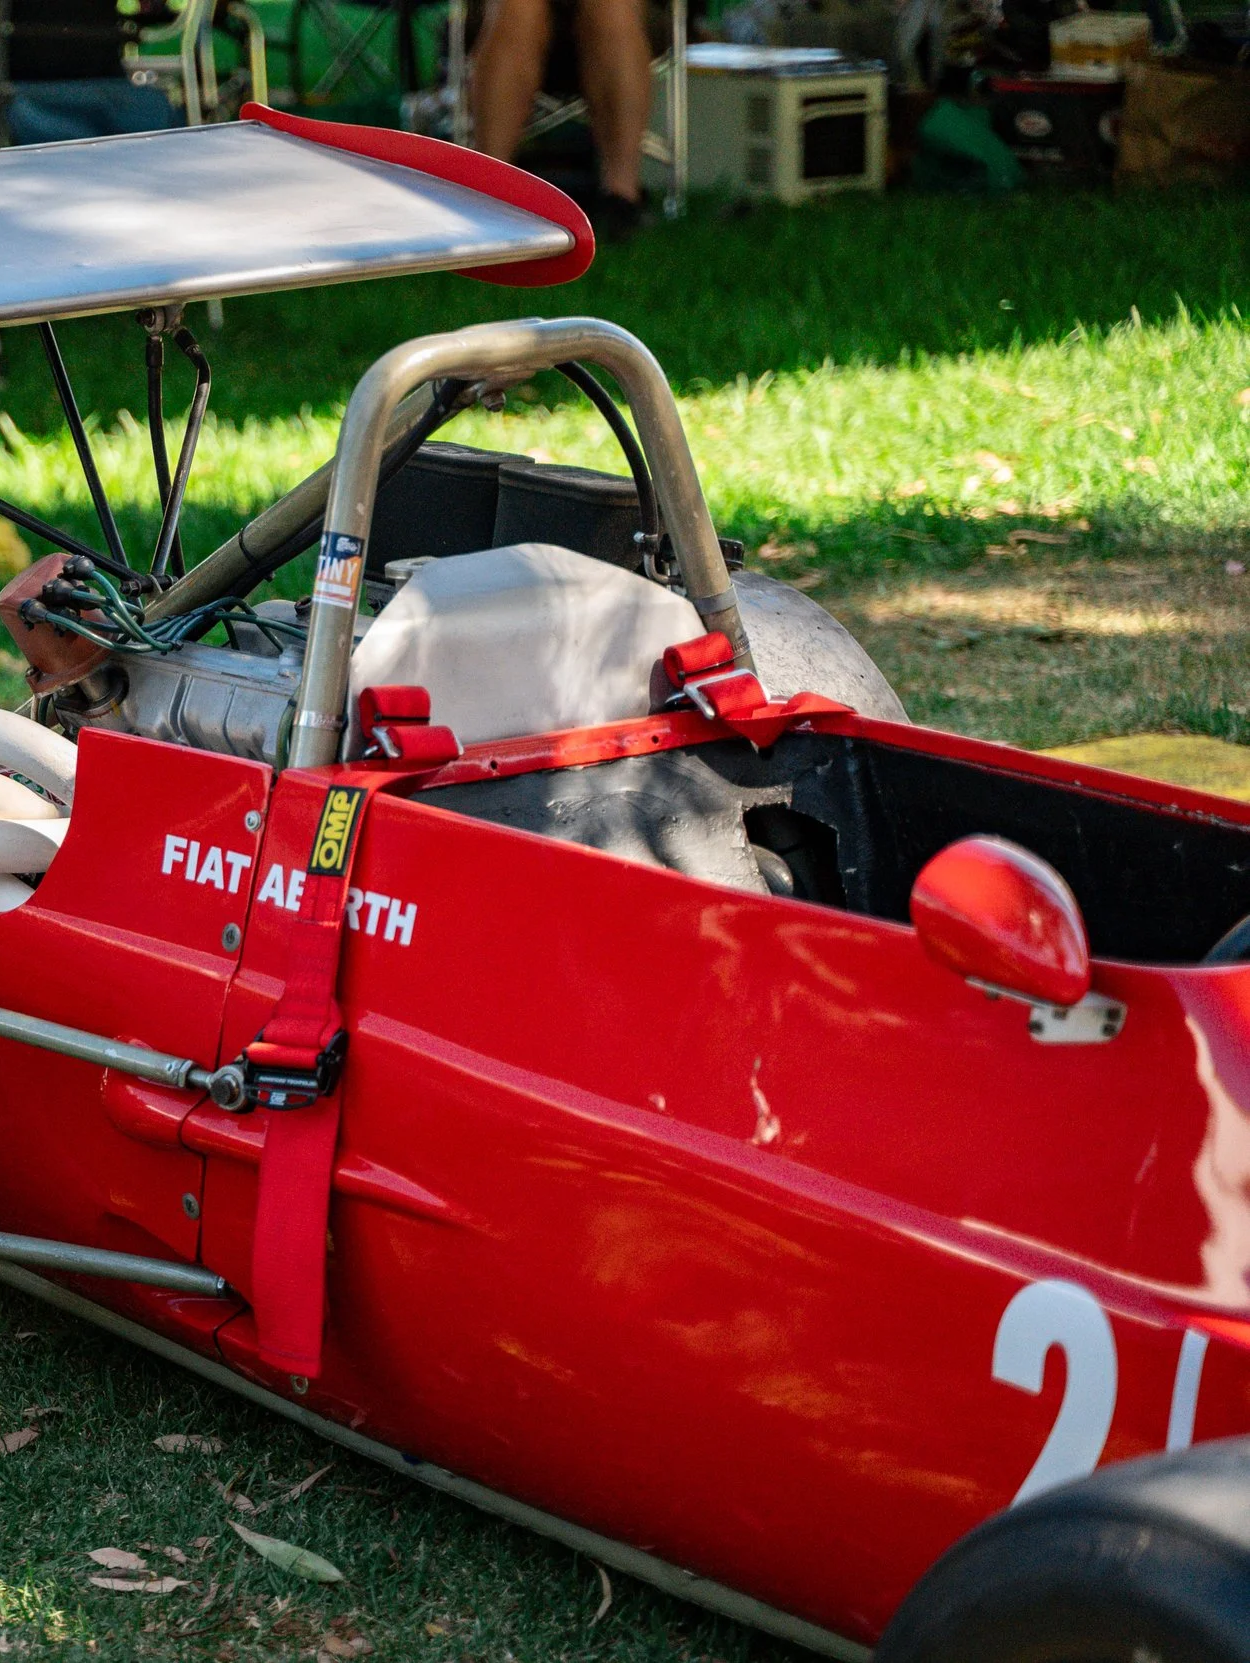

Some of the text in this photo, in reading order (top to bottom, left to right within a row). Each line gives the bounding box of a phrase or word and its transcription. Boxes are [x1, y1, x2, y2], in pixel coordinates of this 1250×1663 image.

[317, 790, 352, 868] OMP
[161, 834, 418, 947] FIAT ABRTH
